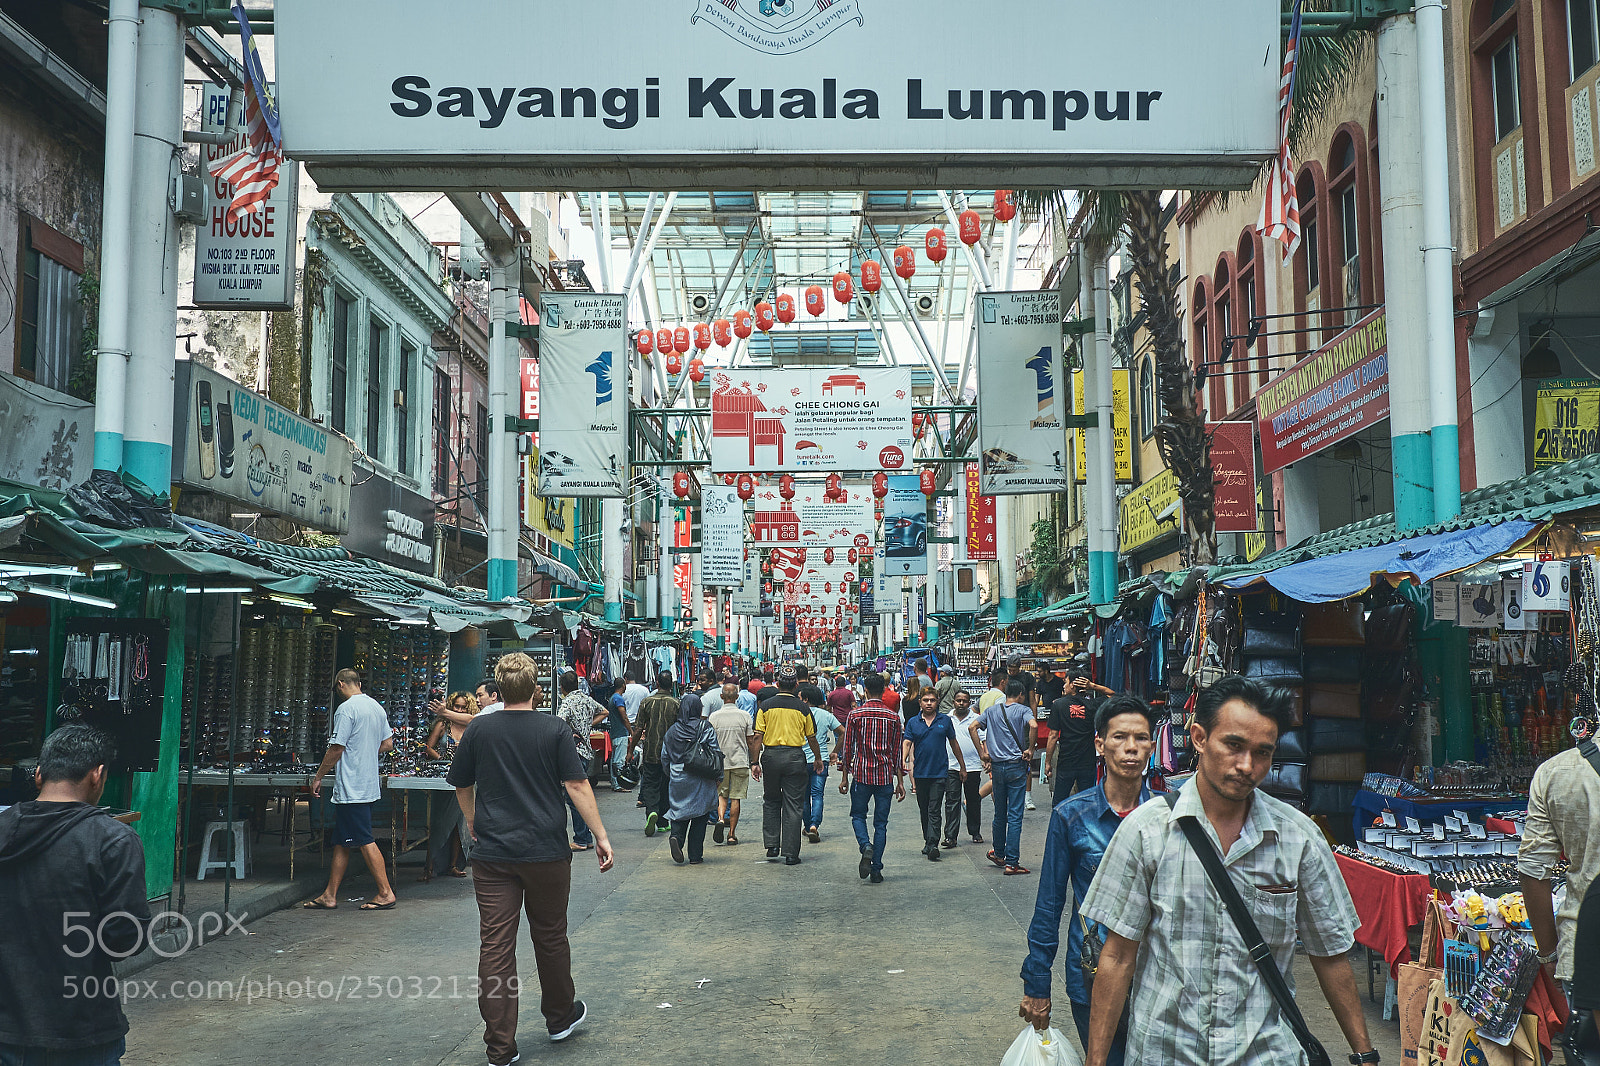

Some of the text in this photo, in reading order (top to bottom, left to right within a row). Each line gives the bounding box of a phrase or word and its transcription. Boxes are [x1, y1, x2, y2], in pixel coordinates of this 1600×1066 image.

[705, 4, 852, 50] Dewan Bandaraya Kuala Lumpur
[390, 76, 1162, 130] Sayangi Kuala Lumpur
[212, 206, 275, 238] HOUSE
[208, 248, 232, 260] NO.103
[251, 248, 275, 260] FLOOR
[254, 264, 280, 275] PETALING
[219, 279, 262, 290] KUALA LUMPUR
[1318, 348, 1334, 384] DAN
[1333, 327, 1368, 375] PAKAIAN
[1367, 313, 1387, 354] TERP
[1300, 385, 1333, 421] CLOTHING
[1333, 368, 1360, 402] FAMILY
[1361, 352, 1389, 386] BUNDL
[1557, 397, 1578, 428] 016
[233, 390, 327, 456] KEDAI TELEKOMUNIKASI
[591, 423, 617, 432] Malaysia
[1033, 419, 1060, 429] Malaysia
[881, 451, 902, 463] Tune
[1433, 996, 1438, 1011] I
[1429, 1040, 1434, 1054] I
